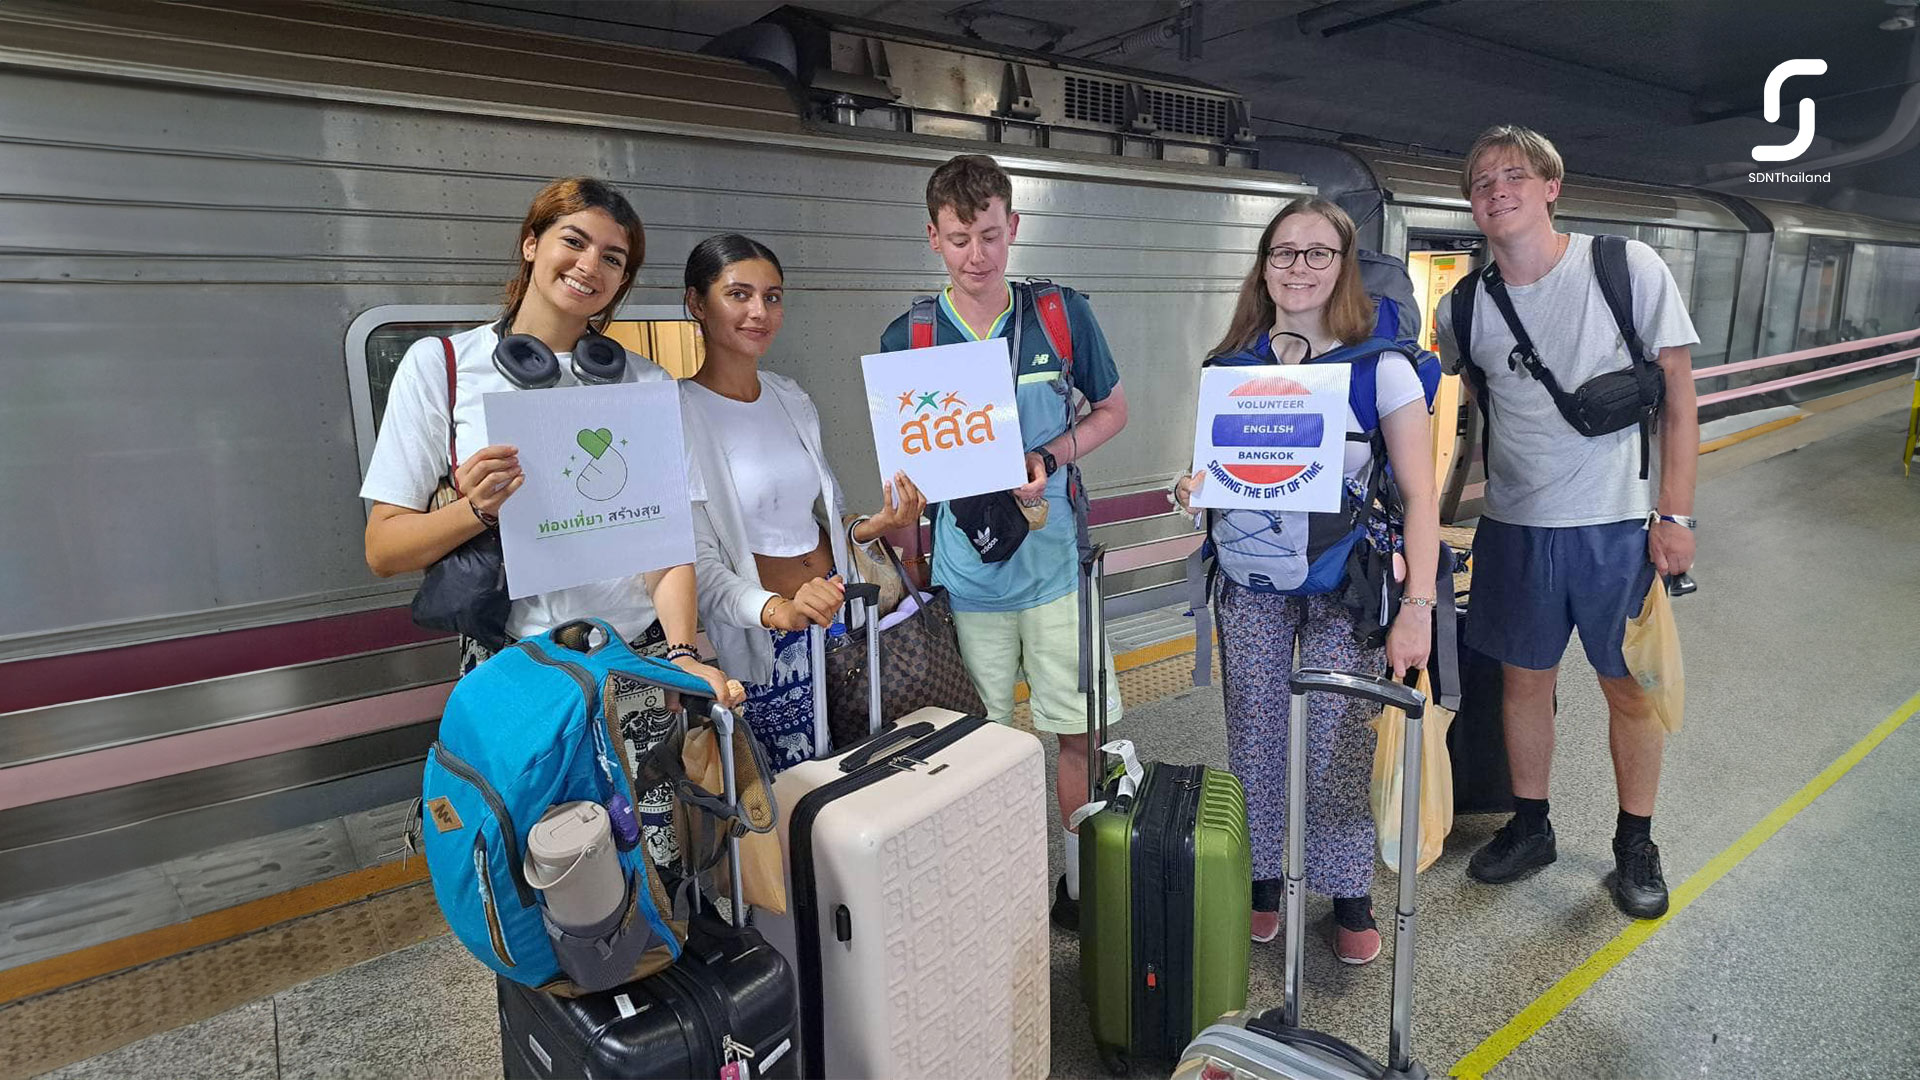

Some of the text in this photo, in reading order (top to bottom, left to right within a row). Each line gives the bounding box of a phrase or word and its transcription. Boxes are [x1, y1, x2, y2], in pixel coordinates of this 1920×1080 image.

[1236, 400, 1305, 409] VOLUNTEER
[1243, 425, 1295, 434] ENGLISH
[1238, 451, 1295, 460] BANGKOK
[1207, 460, 1324, 499] SHARING THE GIFT OF TIME
[538, 504, 661, 533] ท่องเที่ยว สร้างสุข
